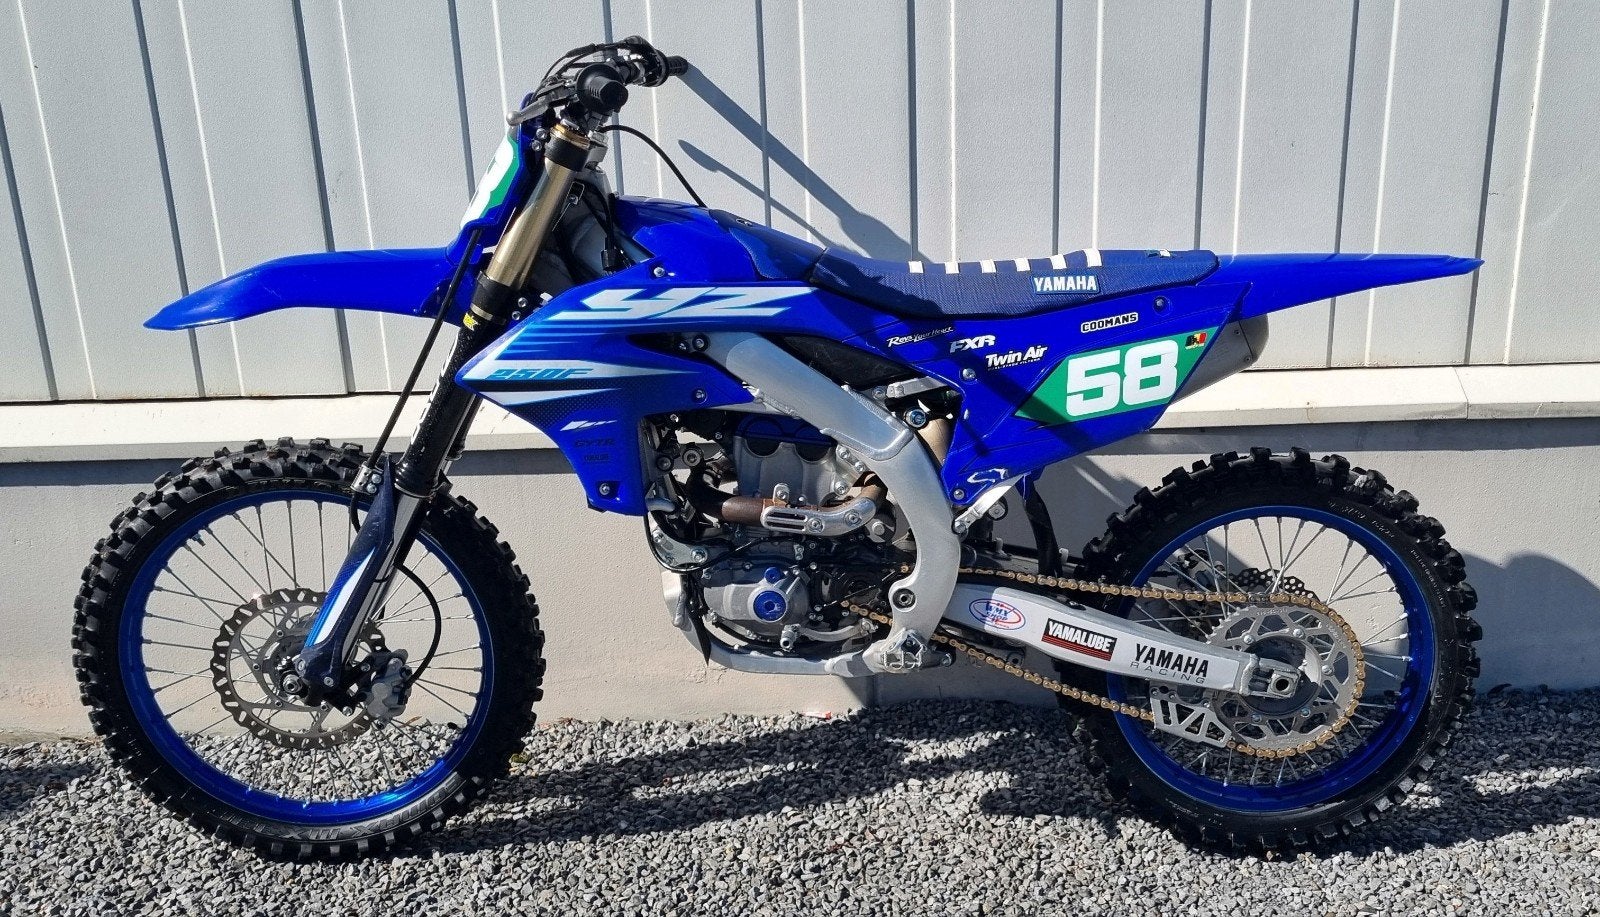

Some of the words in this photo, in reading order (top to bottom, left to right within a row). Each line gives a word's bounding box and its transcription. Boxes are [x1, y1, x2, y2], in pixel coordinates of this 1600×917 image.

[1033, 275, 1097, 292] YAMAHA
[545, 287, 818, 320] YZ
[1082, 313, 1137, 332] COOMANS
[949, 334, 996, 354] FXR
[985, 350, 1022, 368] Twin
[1022, 345, 1048, 361] Air
[485, 368, 595, 380] 250F
[1066, 339, 1179, 417] 58
[1047, 620, 1114, 653] YAMALUBE
[1135, 642, 1209, 678] YAMAHA
[1129, 660, 1207, 685] RACING
